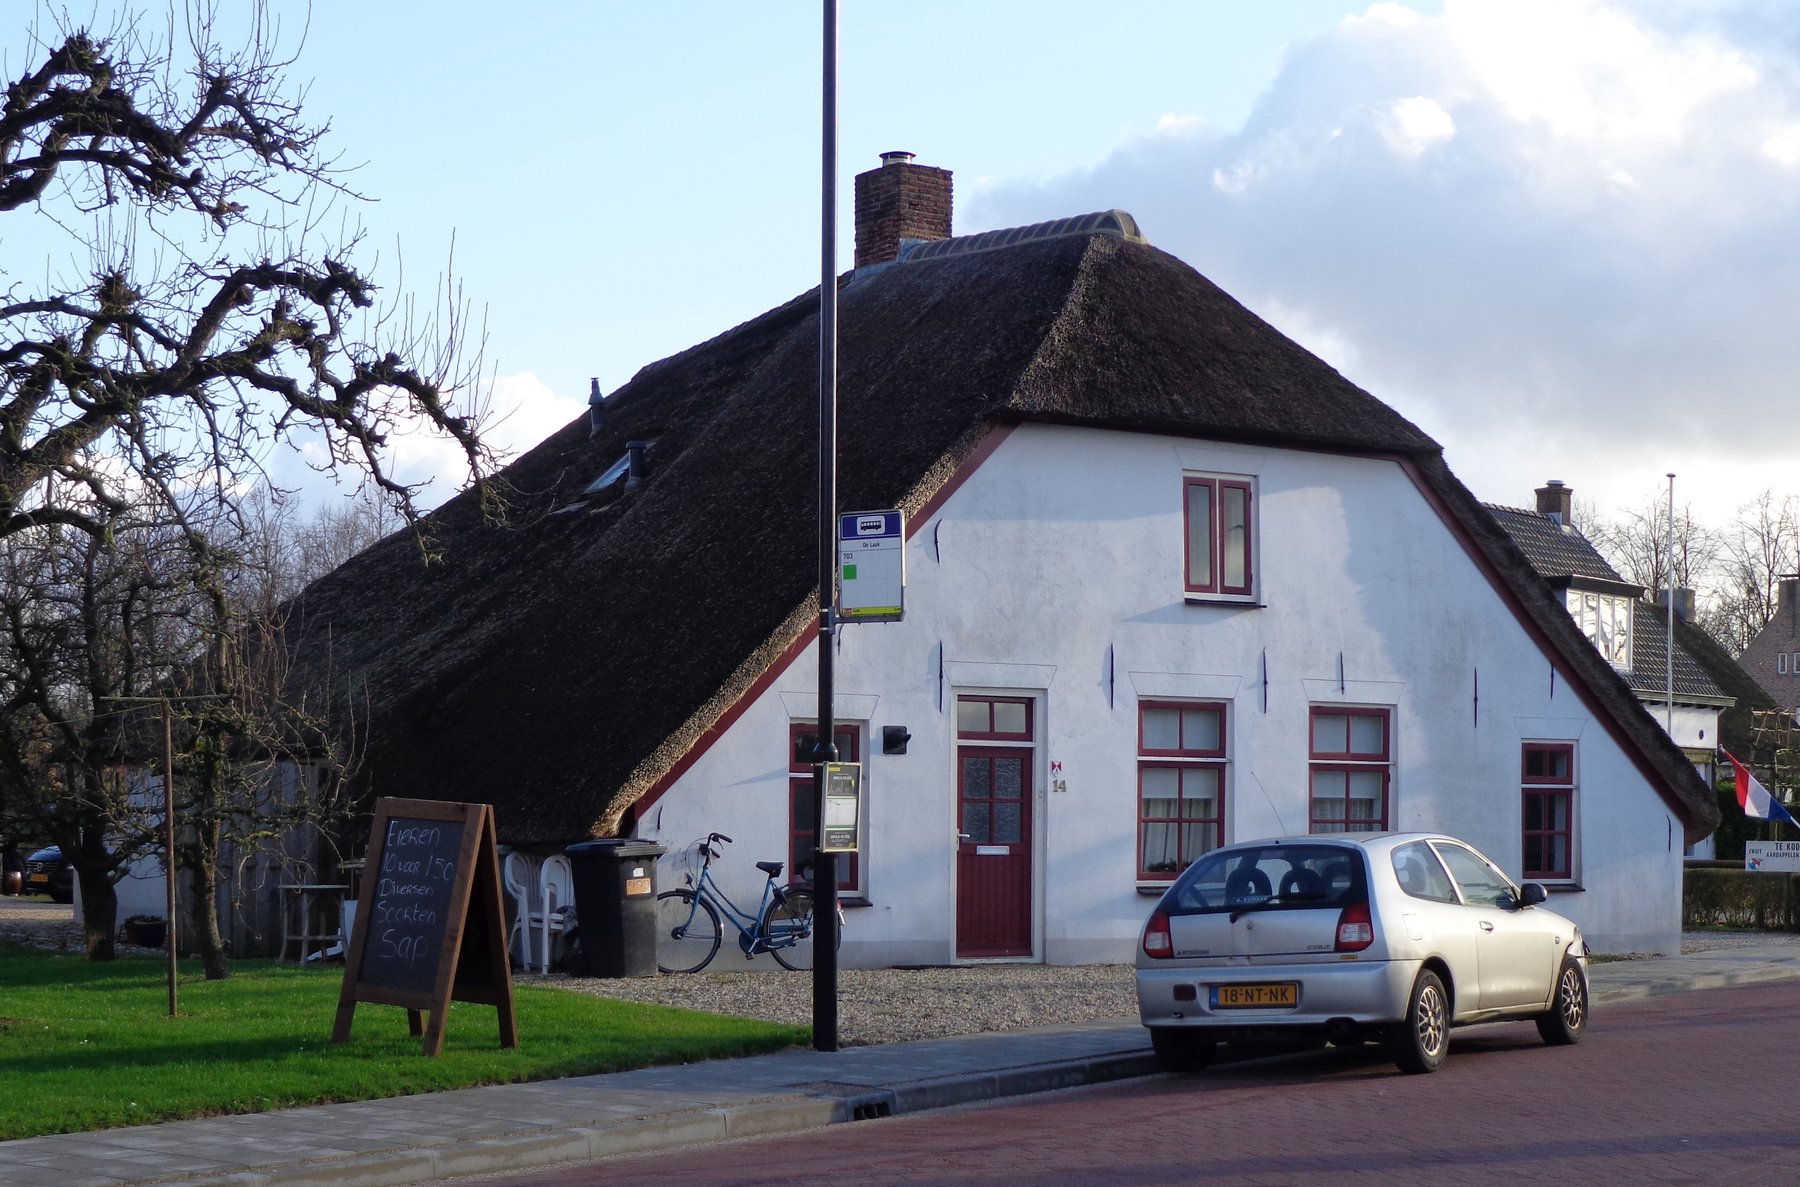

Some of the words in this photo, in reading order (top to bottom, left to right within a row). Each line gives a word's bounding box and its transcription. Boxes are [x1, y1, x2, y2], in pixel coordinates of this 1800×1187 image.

[1052, 779, 1067, 793] 14
[1775, 842, 1784, 851] TE
[1224, 987, 1289, 1003] 18-NT-NK
